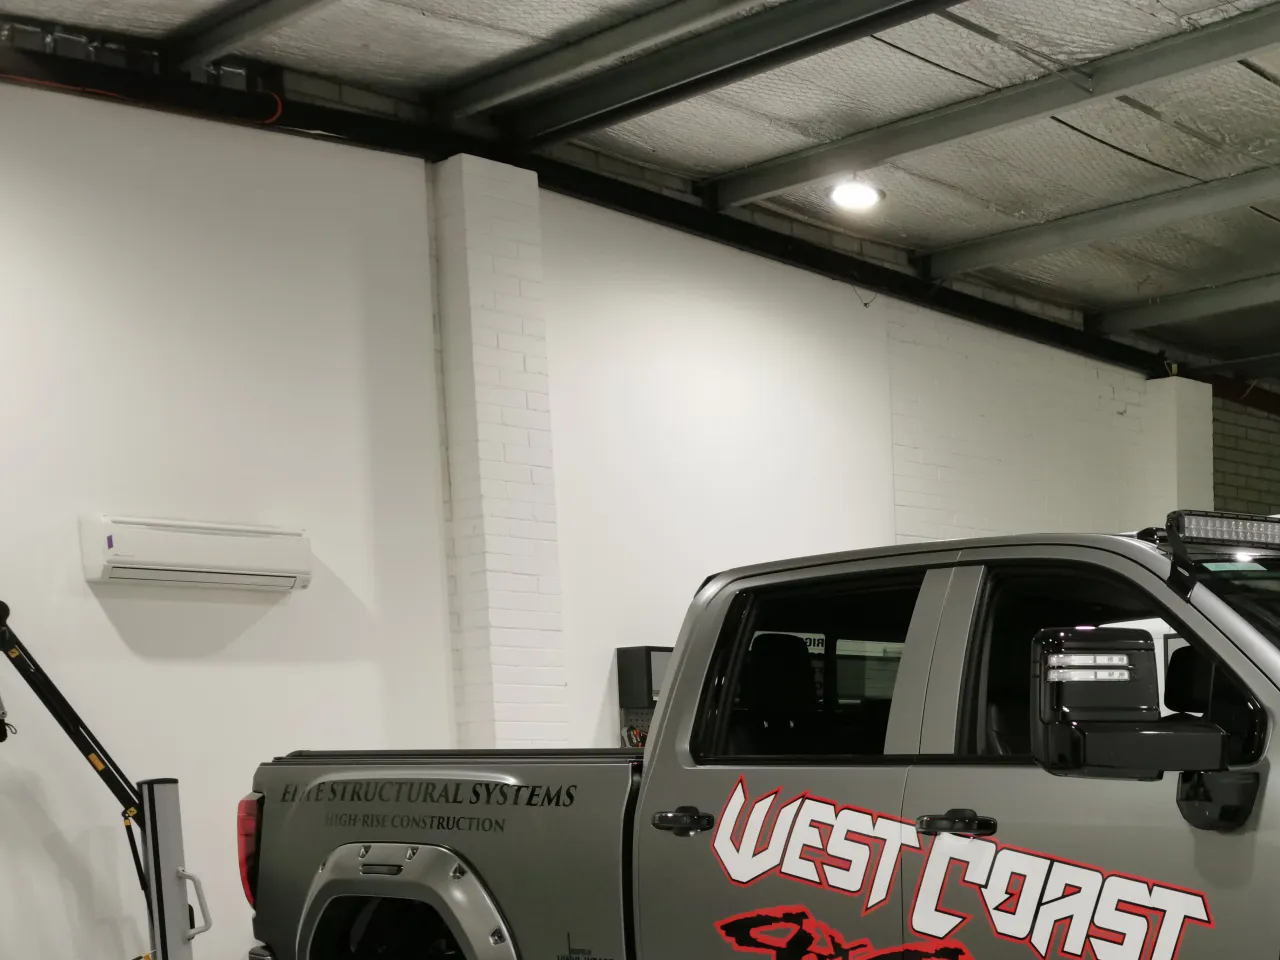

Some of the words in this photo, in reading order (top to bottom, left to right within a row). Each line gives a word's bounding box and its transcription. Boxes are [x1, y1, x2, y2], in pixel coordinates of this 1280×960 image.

[327, 781, 464, 804] STRUCTURAL
[468, 783, 578, 808] SYSTEMS
[324, 812, 388, 829] HIGH-RISE
[391, 814, 506, 832] CONSTRUCTION
[711, 774, 926, 916] WEST
